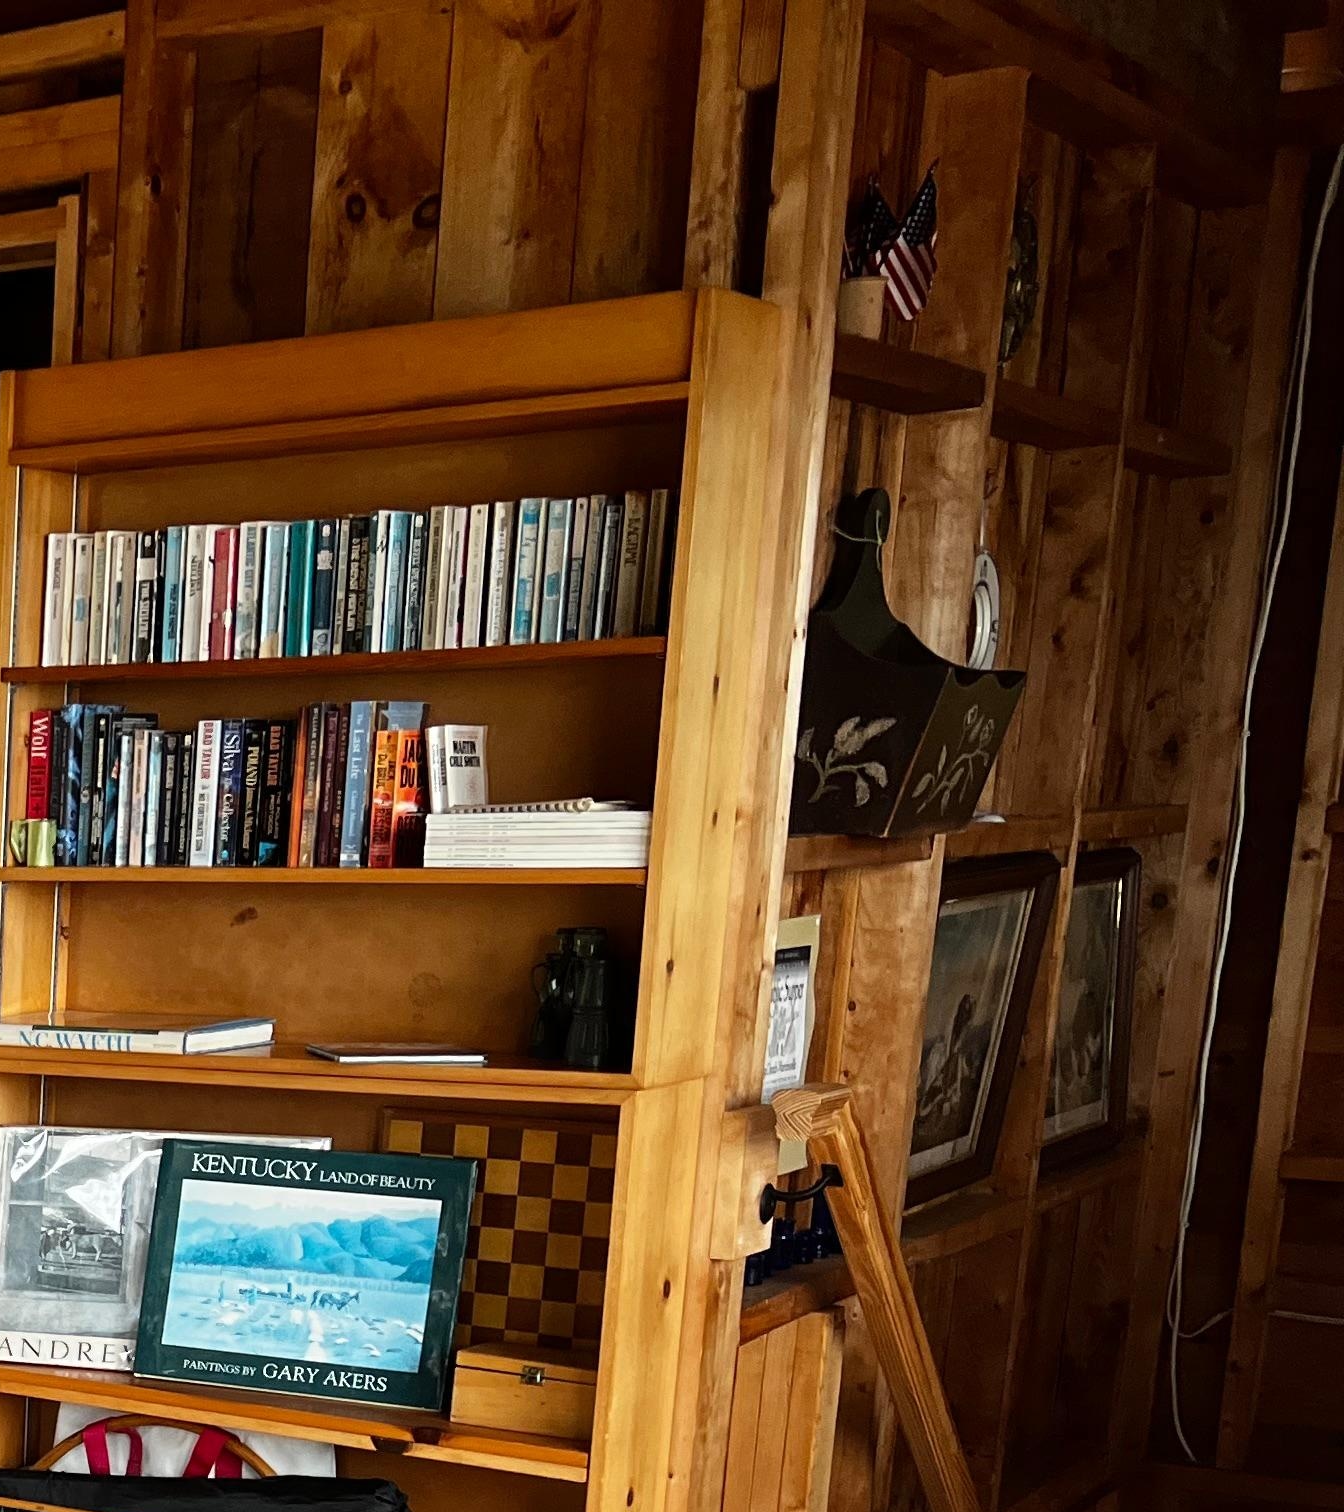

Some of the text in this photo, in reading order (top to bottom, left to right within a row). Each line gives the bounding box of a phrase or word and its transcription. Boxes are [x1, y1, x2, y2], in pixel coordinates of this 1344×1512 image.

[624, 518, 641, 568] RAGTIME
[200, 722, 214, 780] BRAD TAYLOR
[221, 733, 240, 772] Silva
[269, 726, 282, 750] BRAD
[352, 729, 365, 753] Last
[452, 740, 477, 754] MARTIN
[29, 717, 49, 798] Wolf Hall
[245, 746, 259, 786] POLAND
[266, 752, 280, 786] TAYLOR
[350, 757, 363, 780] Life
[220, 793, 233, 842] Collector
[191, 1153, 436, 1191] KENTUCKY LAND OF BEAUTY
[182, 1359, 388, 1393] PAINTINGS BY GARY AKERS
